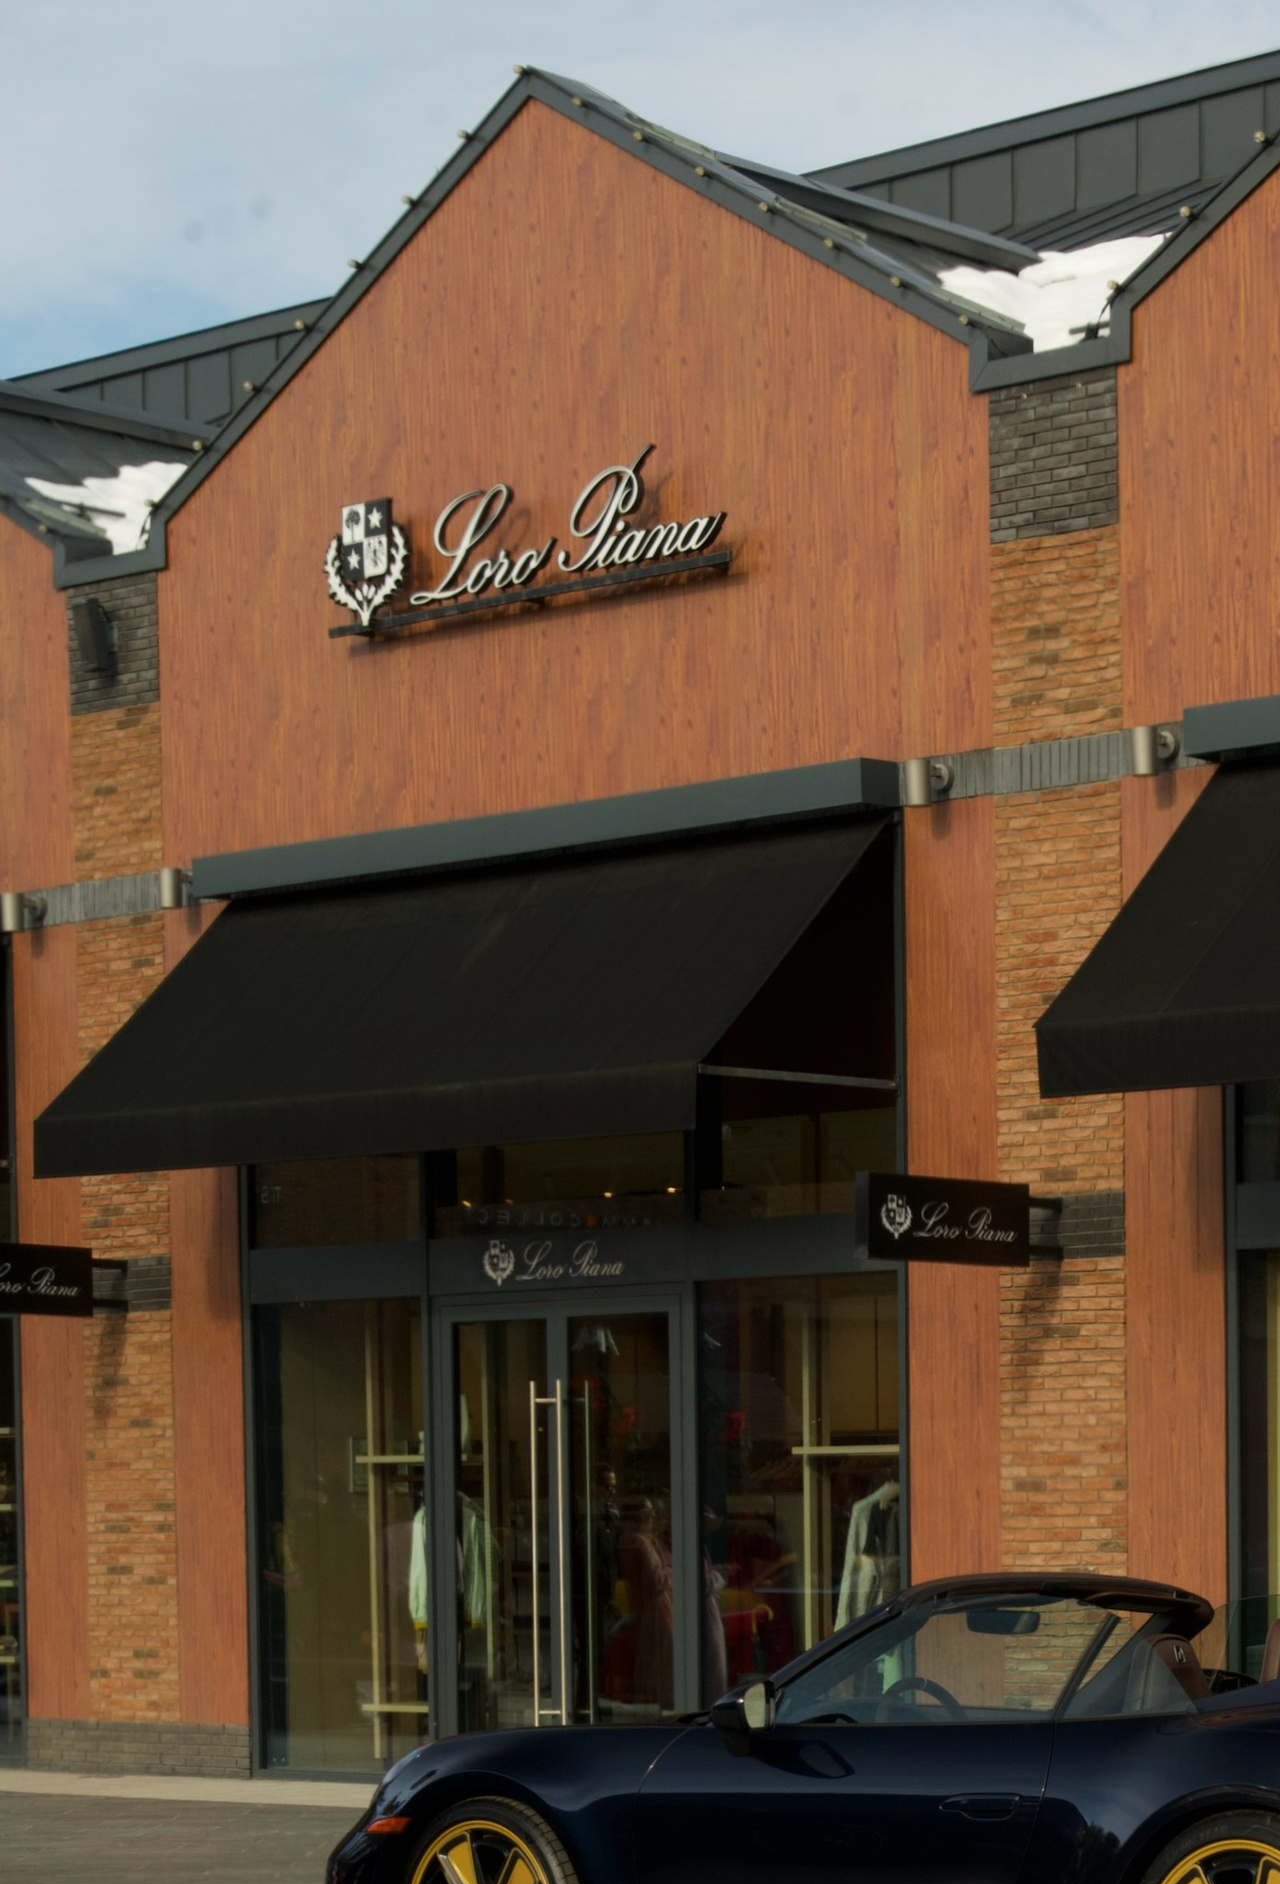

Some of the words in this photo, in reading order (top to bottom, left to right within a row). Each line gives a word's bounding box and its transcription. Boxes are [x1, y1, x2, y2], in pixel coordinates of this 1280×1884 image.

[410, 483, 557, 605] Loro
[558, 443, 728, 572] Piana
[912, 1200, 963, 1239] Loro
[964, 1204, 1018, 1243] Piana
[27, 1264, 81, 1297] Piana
[515, 1240, 567, 1281] Loro
[569, 1238, 626, 1277] Piana
